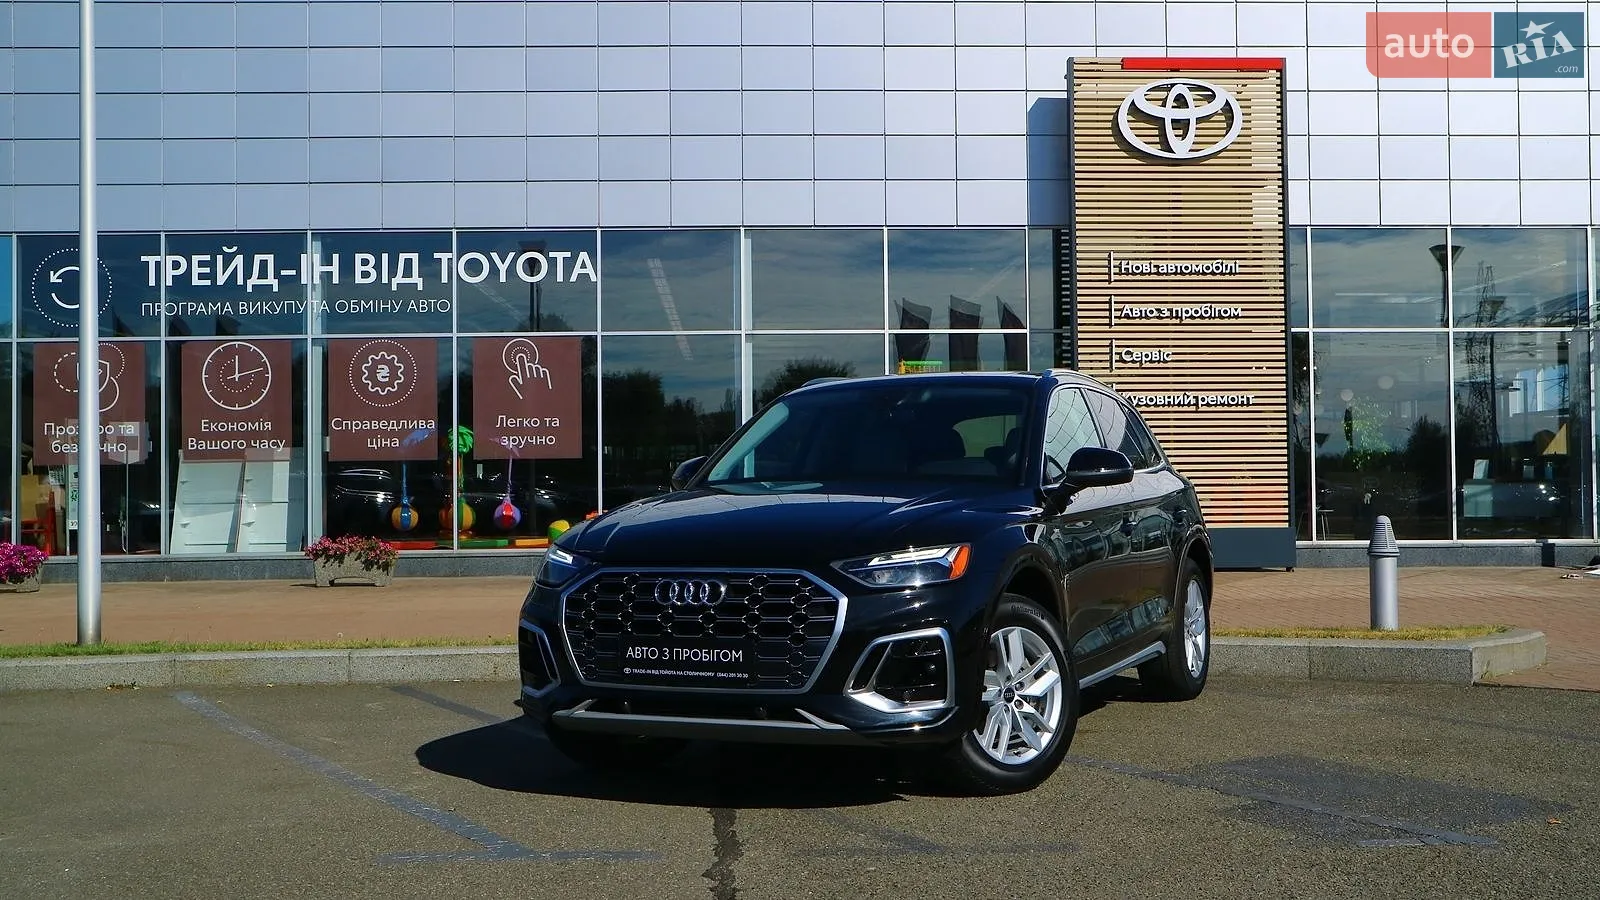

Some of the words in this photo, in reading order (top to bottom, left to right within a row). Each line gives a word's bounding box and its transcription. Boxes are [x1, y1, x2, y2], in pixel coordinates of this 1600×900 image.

[140, 246, 340, 293] ТРЕЙД-ІН
[354, 252, 423, 291] ВІД
[433, 250, 597, 284] TOYOTA
[1120, 260, 1155, 275] Нові
[1158, 259, 1239, 274] автомобілі
[141, 301, 234, 317] ПРОГРАМА
[239, 300, 306, 315] ВИКУПУ
[335, 299, 403, 315] ОБМІНУ
[407, 299, 451, 314] АВТО
[1121, 304, 1156, 318] Авто
[1160, 308, 1168, 318] з
[1172, 303, 1242, 321] пробігом
[1121, 347, 1173, 364] Сервіс
[1198, 396, 1255, 409] ремонт
[118, 424, 135, 434] та
[201, 418, 272, 432] Економія
[331, 417, 436, 433] Справедлива
[496, 415, 541, 429] Легко
[544, 416, 560, 428] та
[51, 439, 127, 454] безчно
[188, 437, 247, 450] Вашого
[251, 439, 286, 452] часу
[367, 434, 400, 449] ціна
[501, 436, 556, 449] зручно
[626, 646, 659, 660] АВТО
[662, 648, 670, 660] З
[673, 648, 743, 662] ПРОБІГОМ
